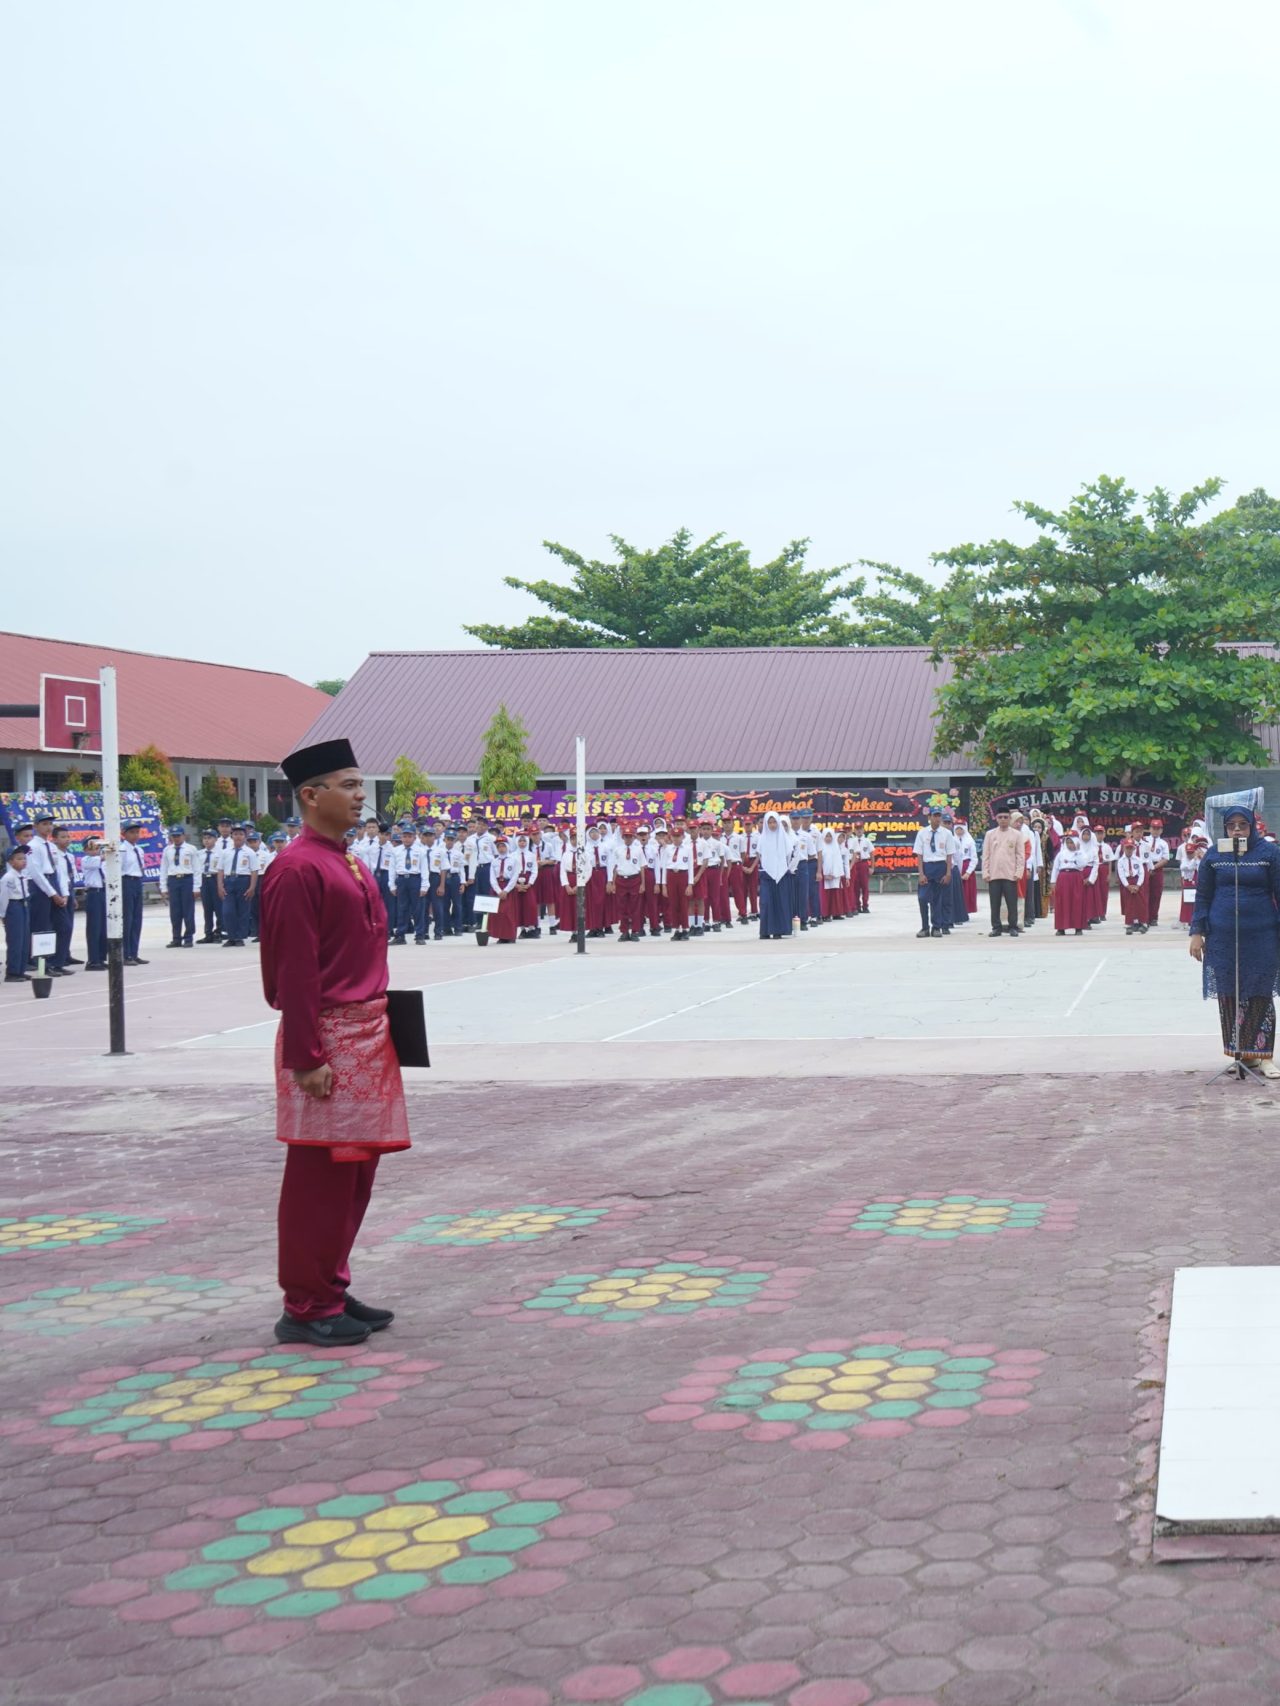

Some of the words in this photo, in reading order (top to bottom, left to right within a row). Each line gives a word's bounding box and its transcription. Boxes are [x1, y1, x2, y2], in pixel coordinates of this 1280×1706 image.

[843, 798, 892, 811] Sukses
[1099, 789, 1174, 811] SUKSES
[26, 805, 84, 820] SLAMAT
[92, 803, 141, 820] SSES
[461, 804, 543, 819] SLAMAT
